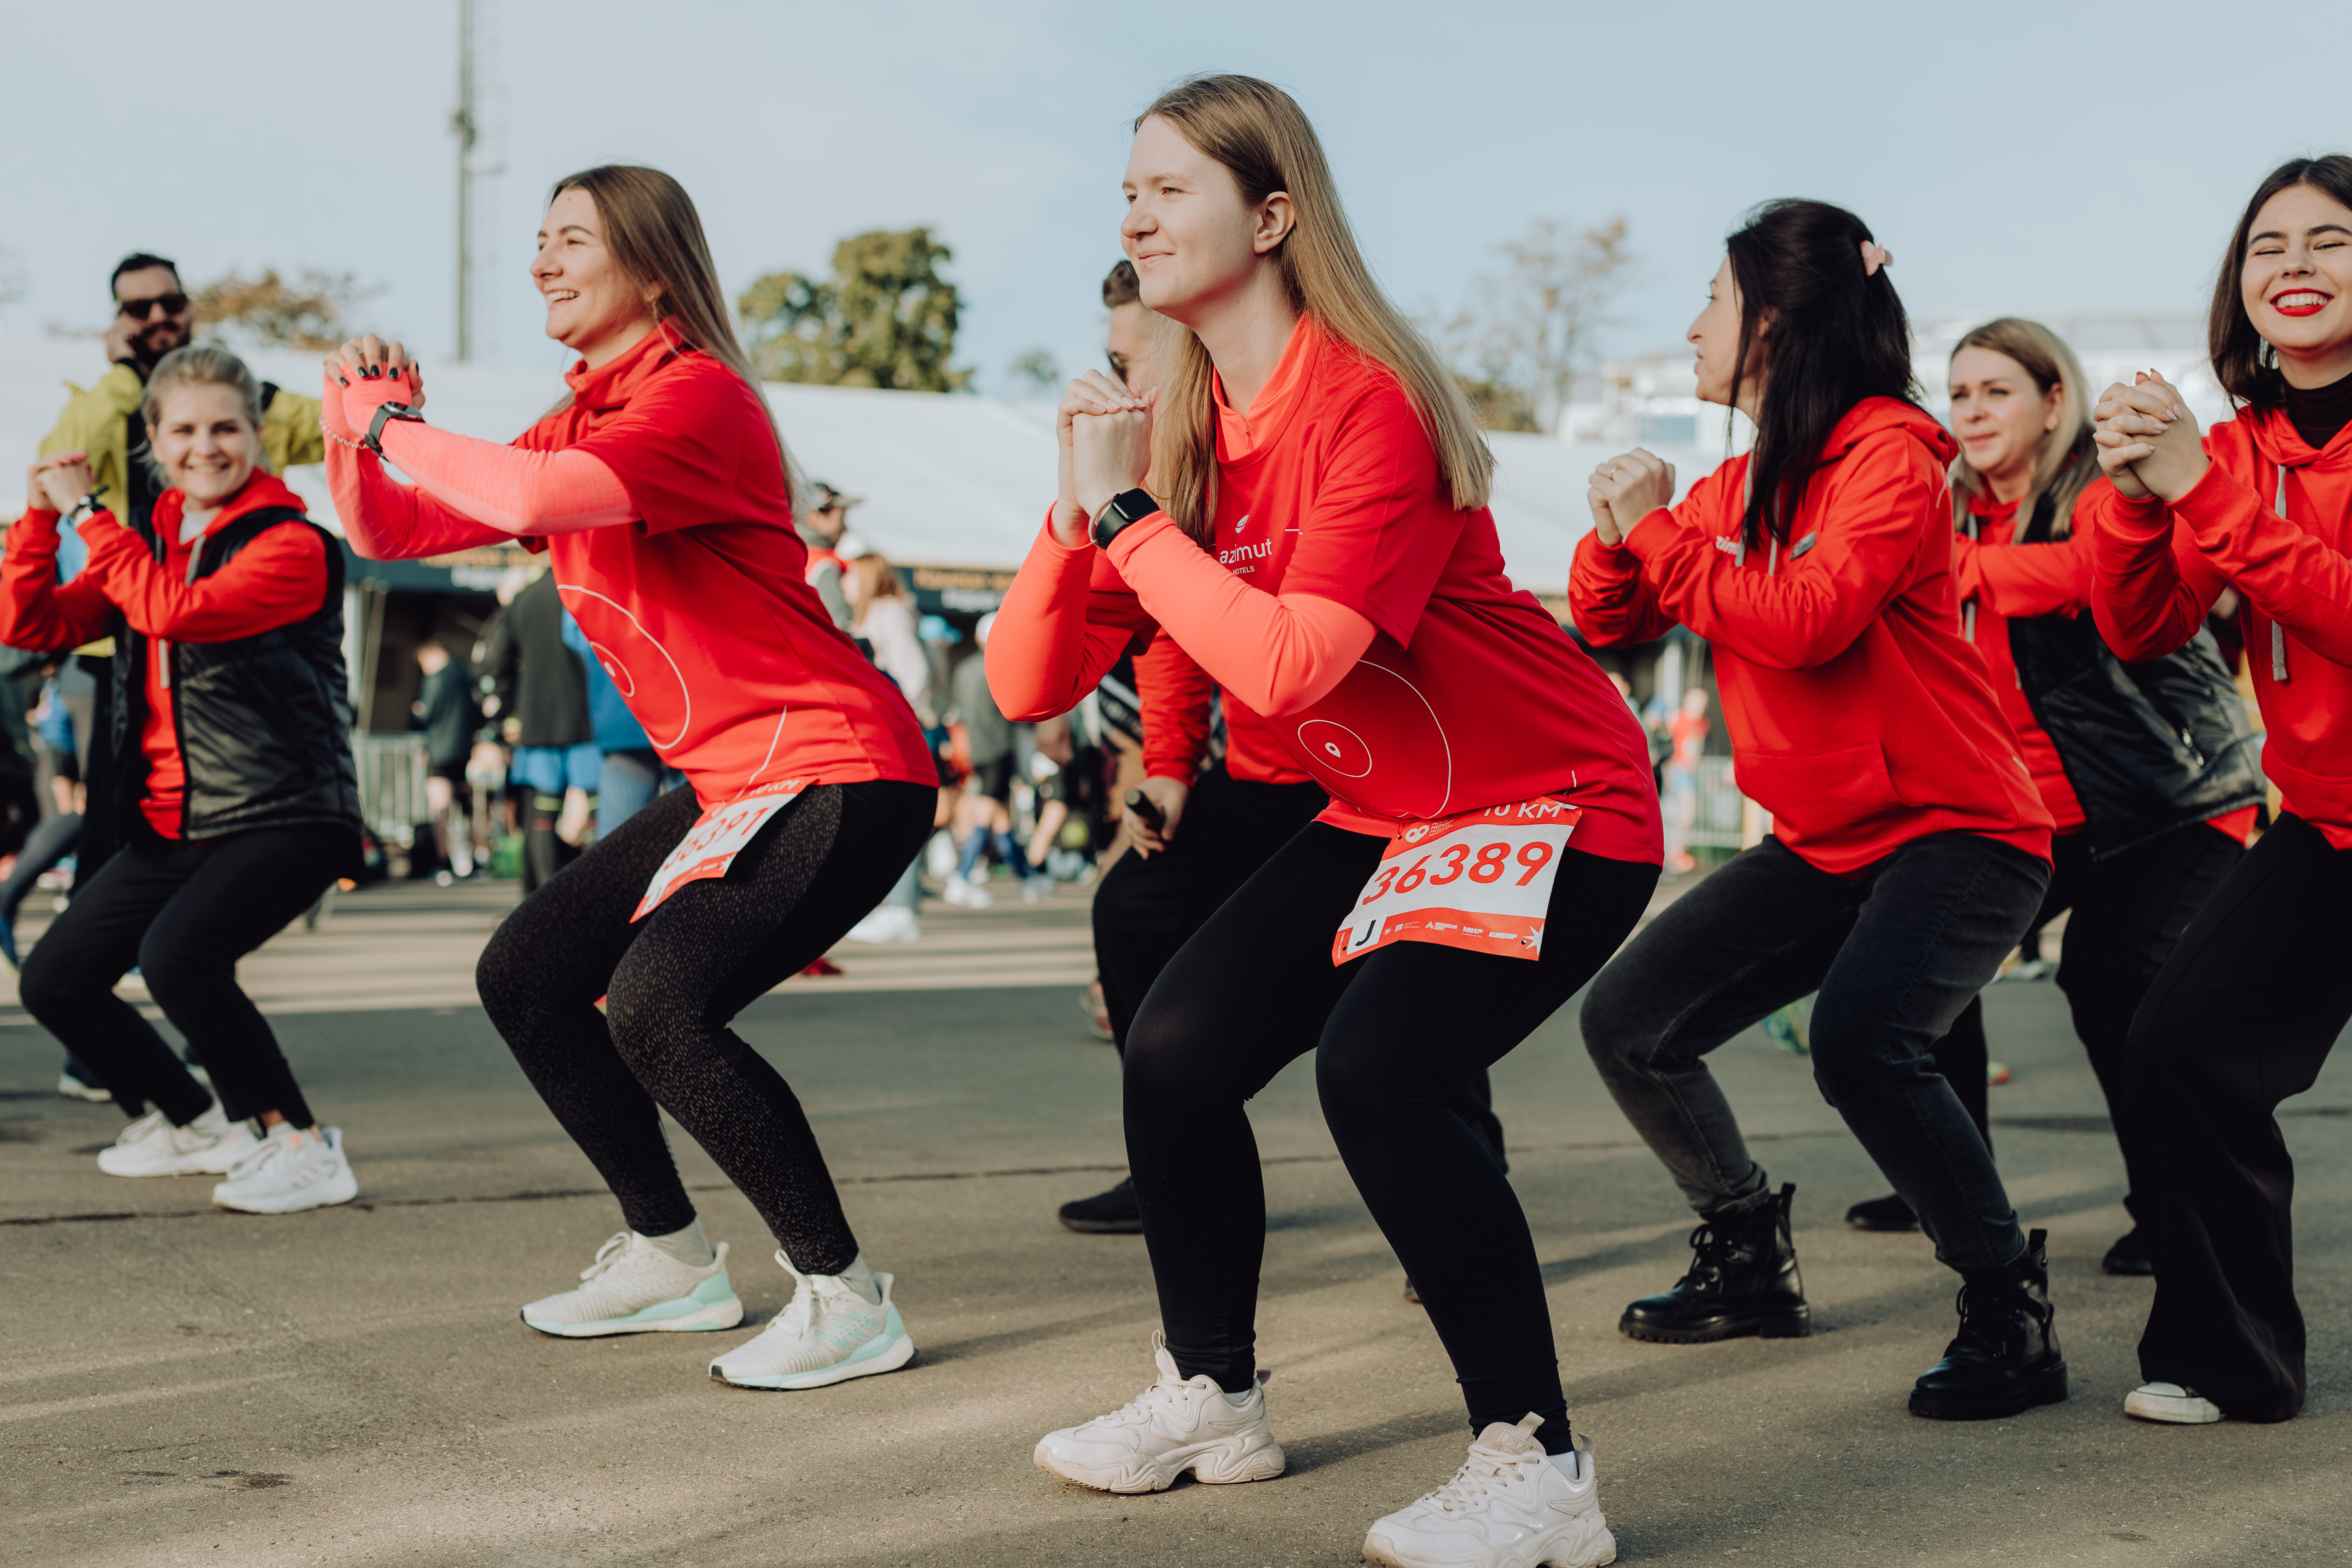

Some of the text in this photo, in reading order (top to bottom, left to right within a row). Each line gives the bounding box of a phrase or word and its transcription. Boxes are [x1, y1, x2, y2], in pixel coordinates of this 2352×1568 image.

[1220, 538, 1272, 564] azimut
[1233, 566, 1255, 575] HOTELS
[1362, 842, 1553, 905] 36389
[1355, 919, 1376, 946] J
[1488, 931, 1517, 940] СИБУР
[1505, 1437, 1524, 1450] FILA
